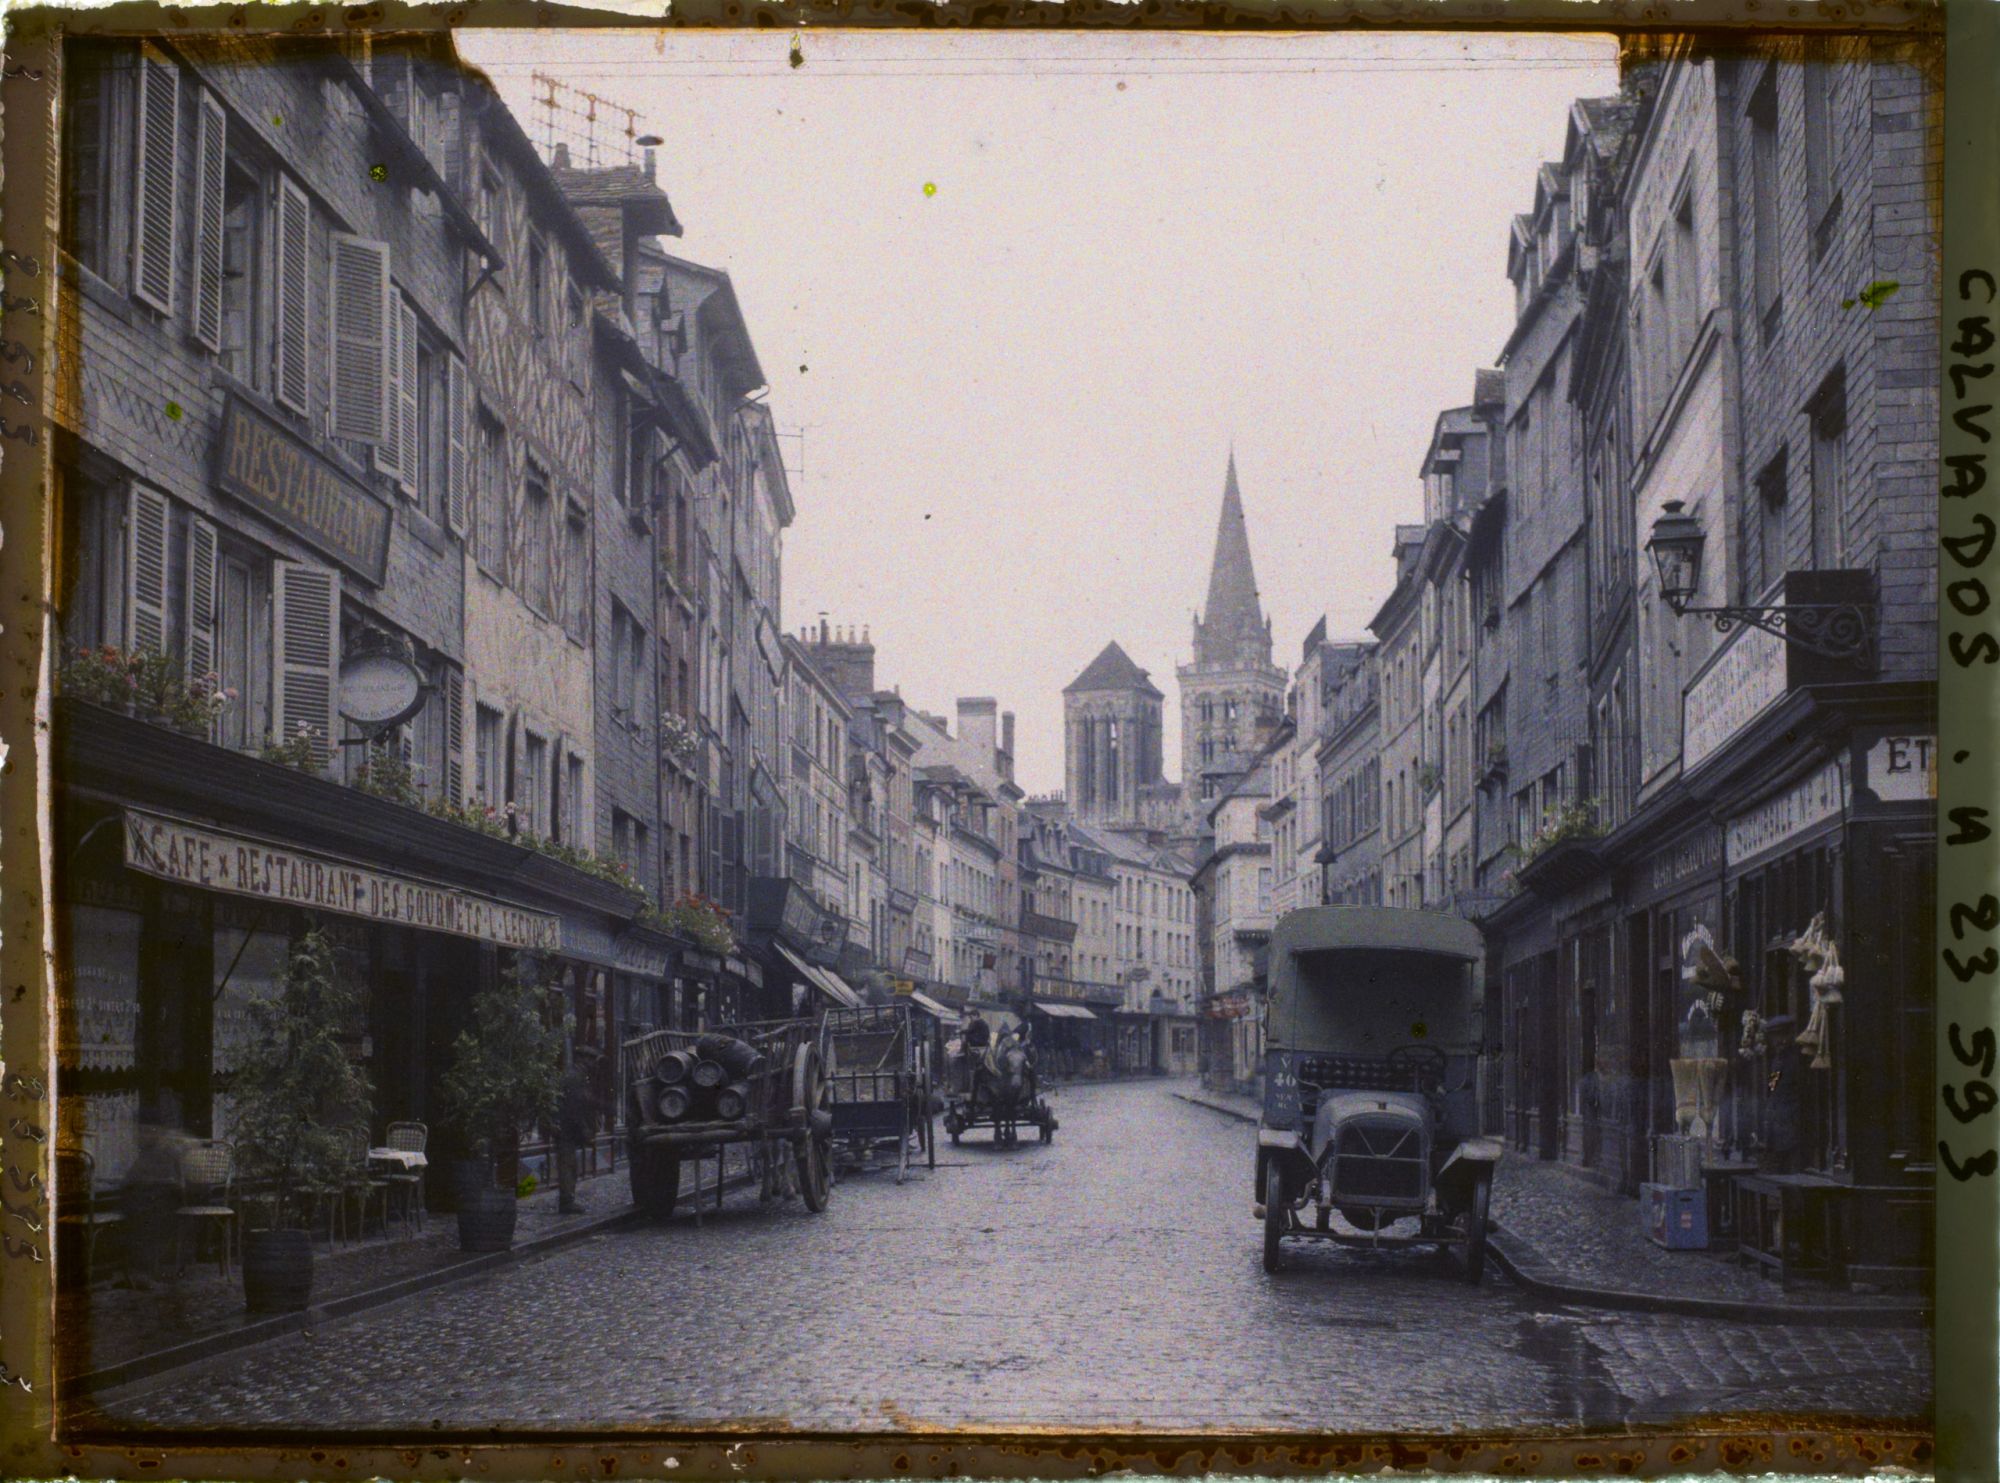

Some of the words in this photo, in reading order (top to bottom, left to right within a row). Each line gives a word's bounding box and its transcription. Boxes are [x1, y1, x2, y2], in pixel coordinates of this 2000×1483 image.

[228, 413, 383, 566] RESTAURANT
[1942, 269, 2000, 669] CALVADOS
[151, 824, 211, 885] CAFE
[237, 847, 361, 911] RESTAURANT
[371, 879, 399, 918] DES
[406, 887, 482, 935] GOURMETS
